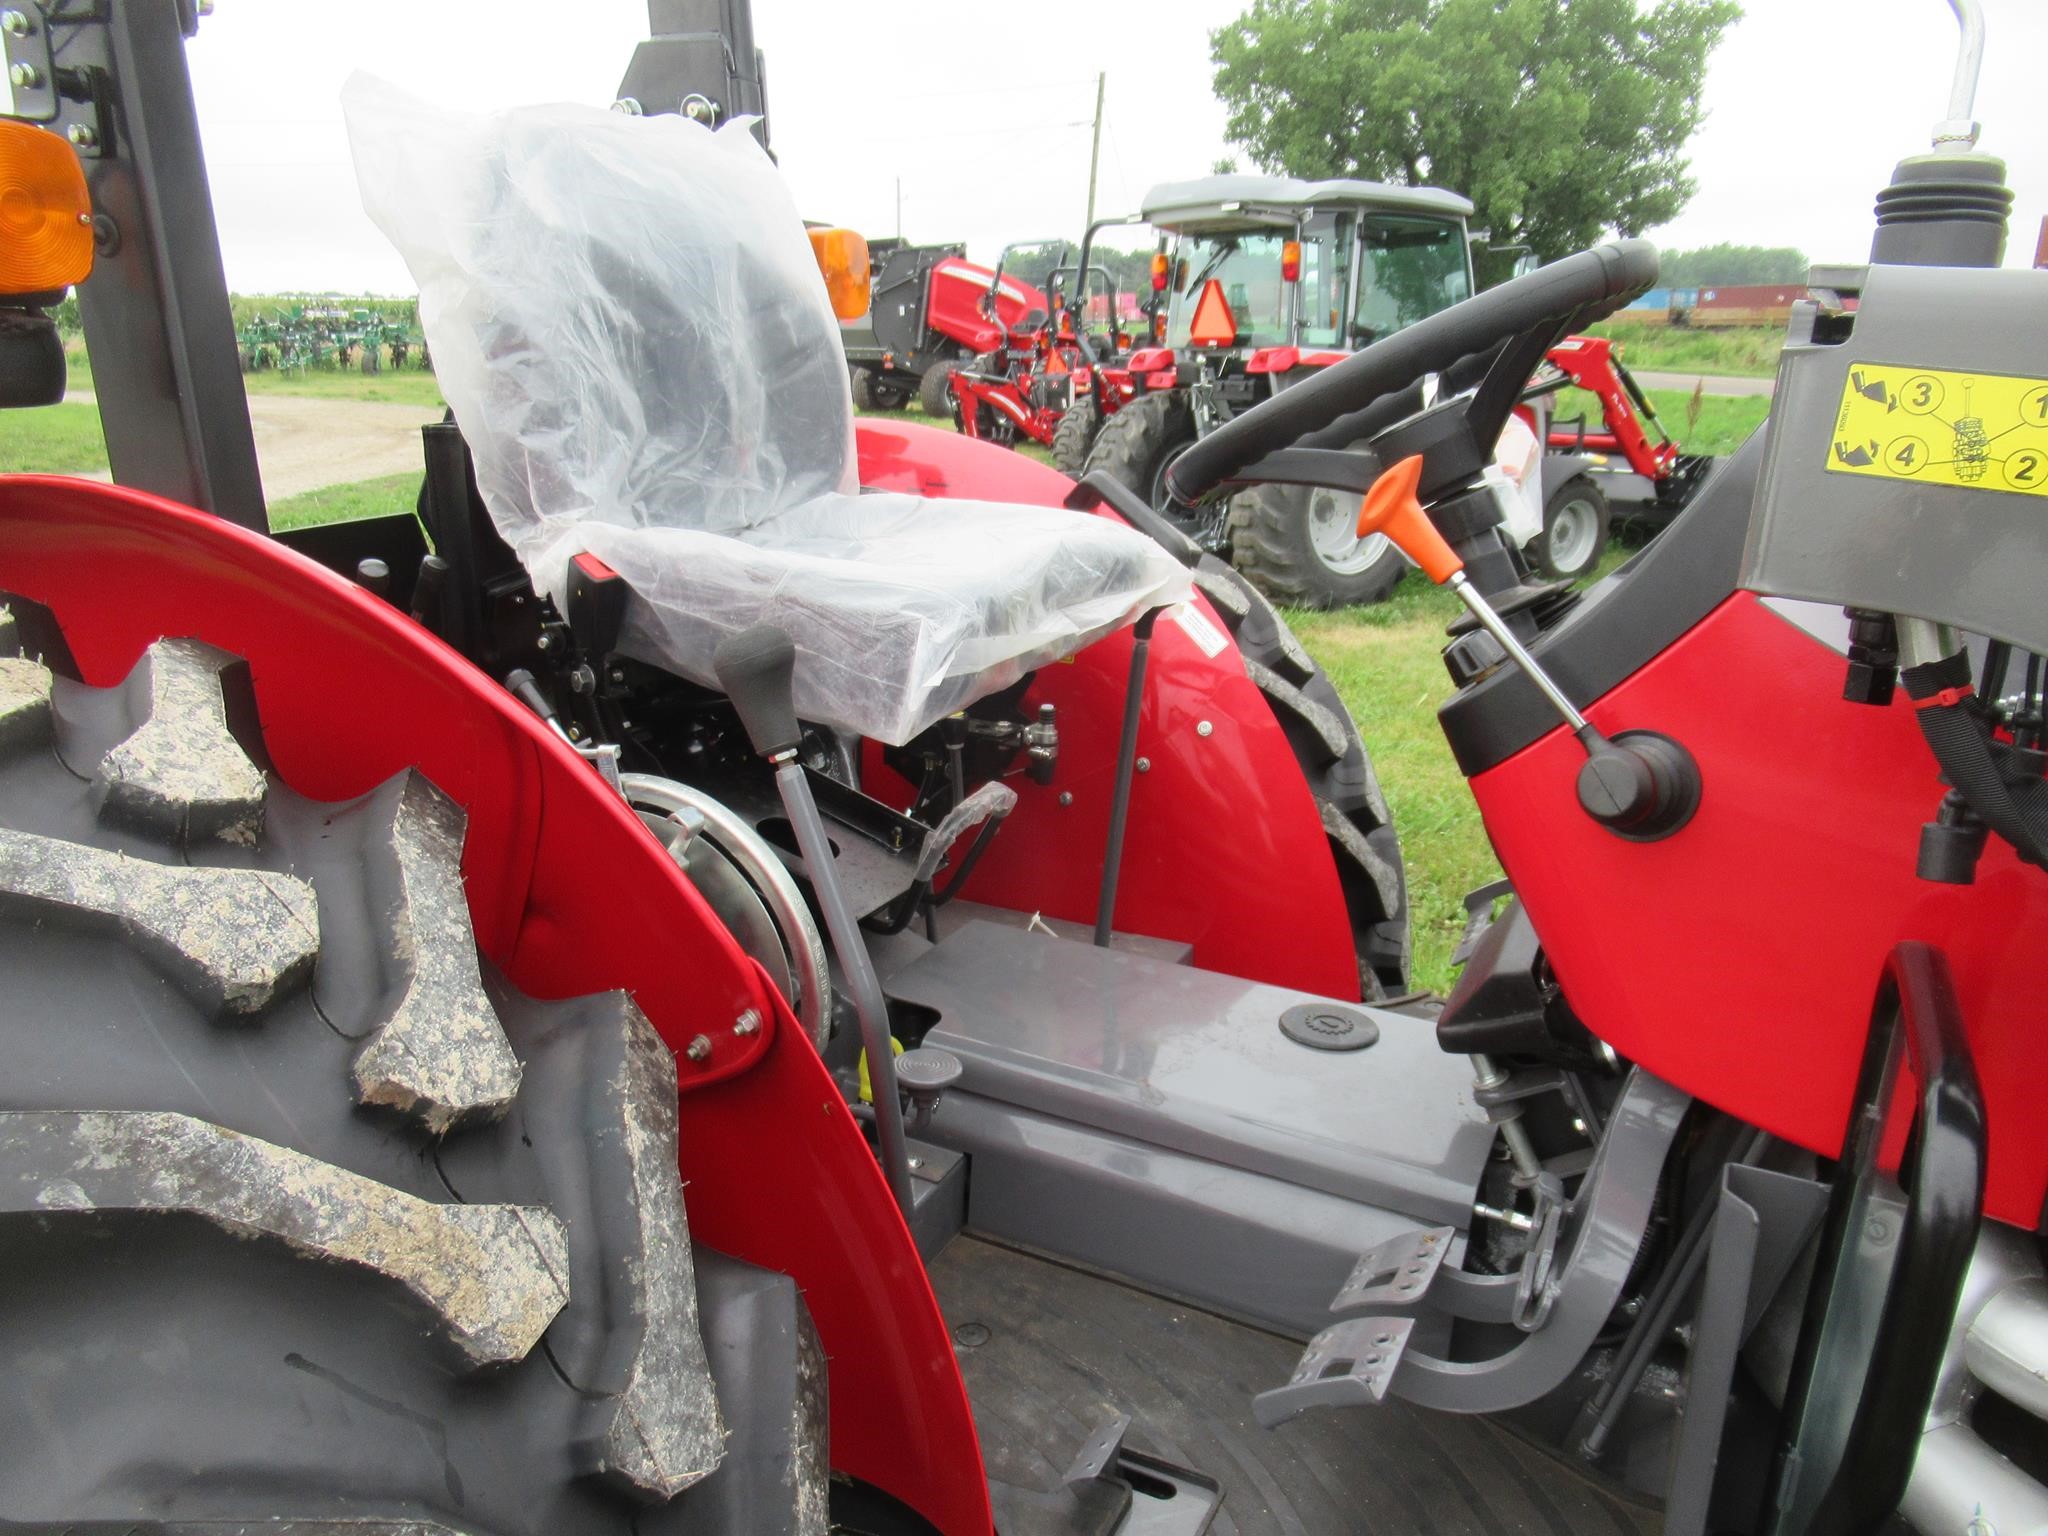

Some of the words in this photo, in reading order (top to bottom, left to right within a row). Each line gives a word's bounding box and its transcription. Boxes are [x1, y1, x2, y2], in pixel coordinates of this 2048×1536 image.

[1912, 382, 1932, 407] 3
[2036, 393, 2048, 418] 1
[1895, 442, 1915, 467] 4
[2014, 455, 2038, 481] 2
